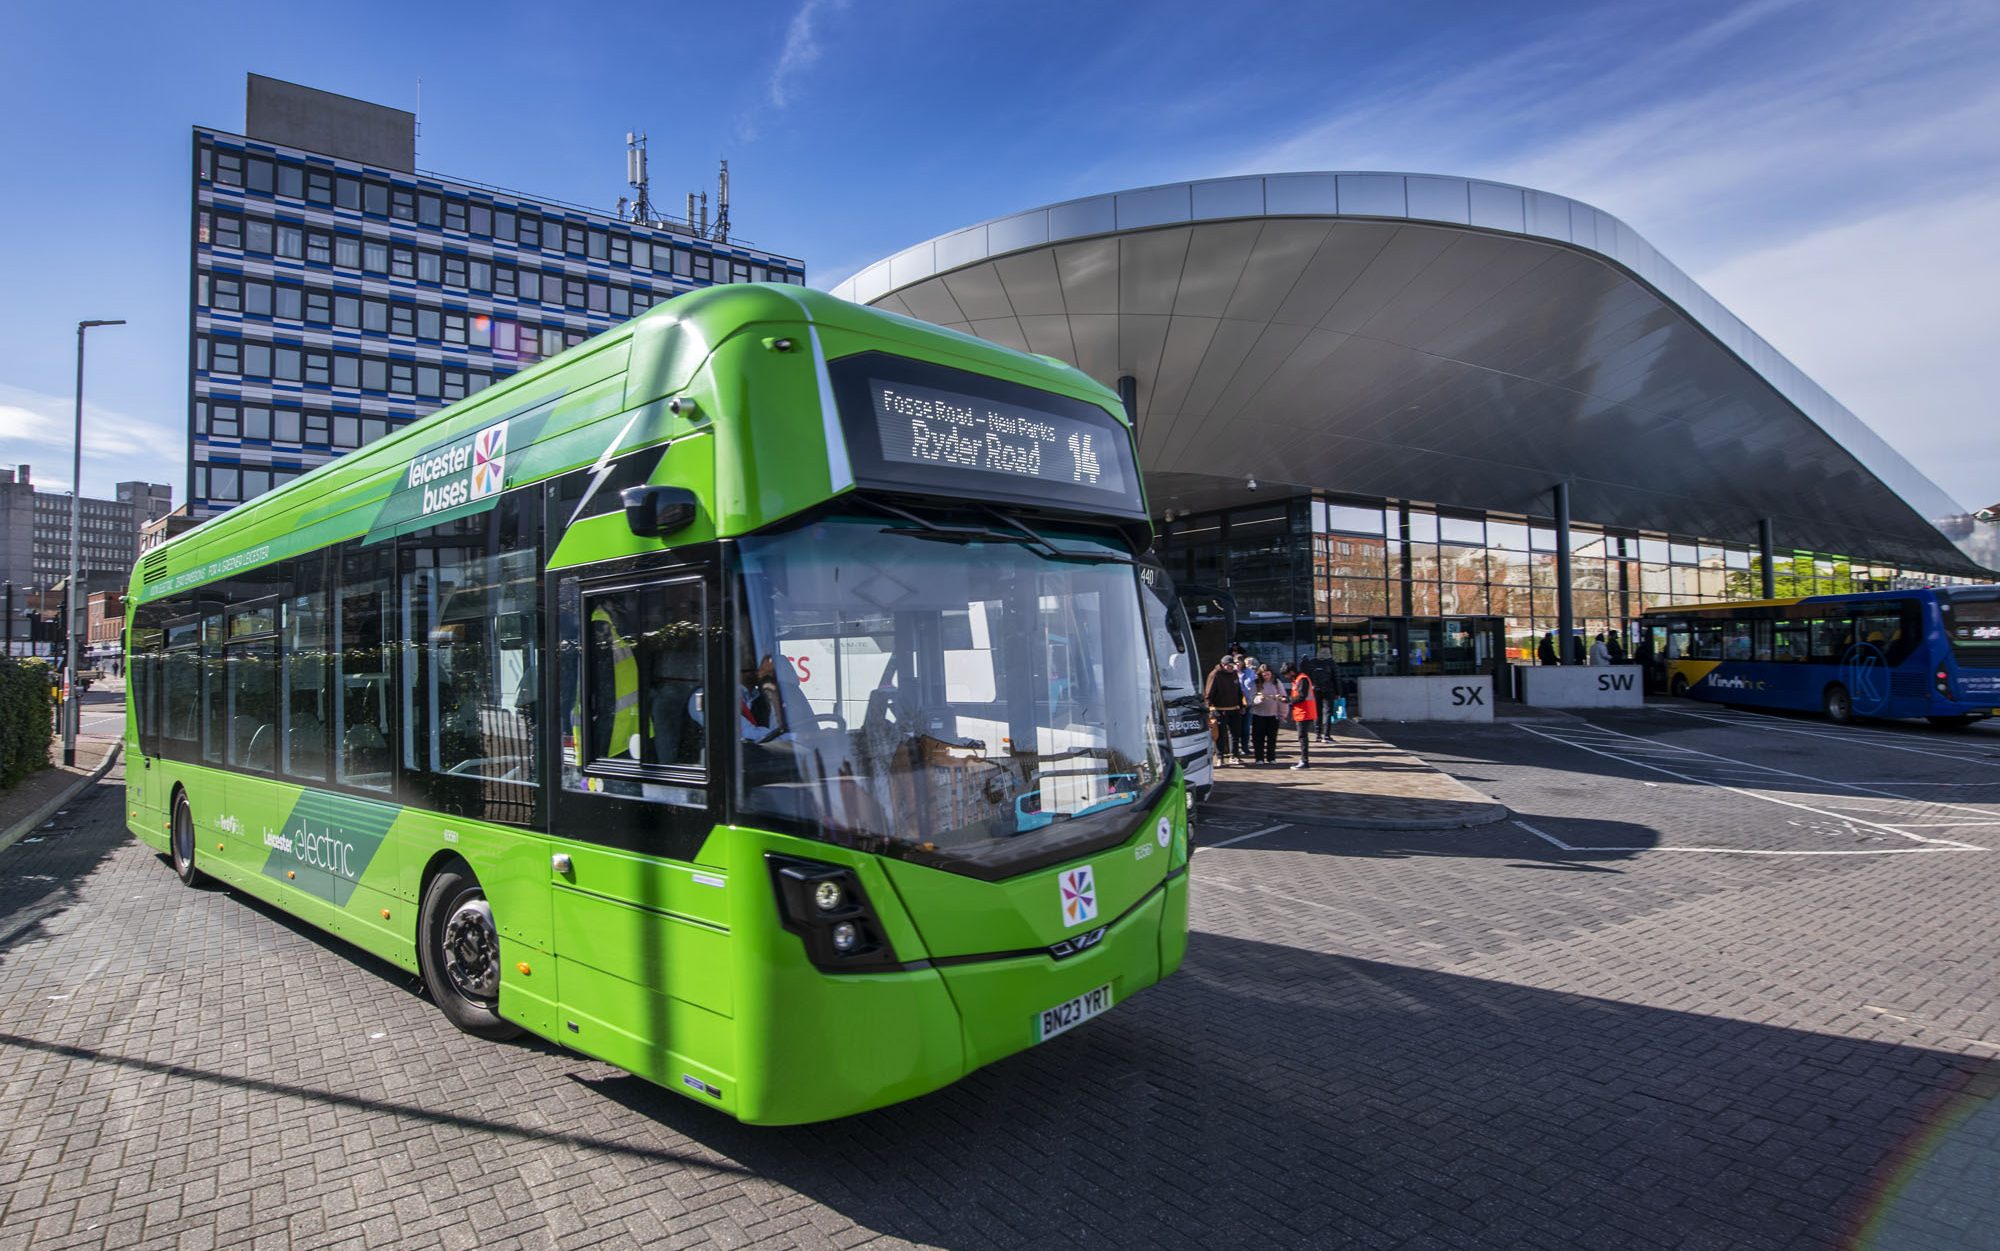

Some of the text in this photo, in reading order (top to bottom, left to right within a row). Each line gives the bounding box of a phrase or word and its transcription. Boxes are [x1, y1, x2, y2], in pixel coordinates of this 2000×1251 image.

[884, 390, 934, 419] Fosse
[935, 401, 974, 427] Road
[987, 411, 1017, 435] New
[1018, 418, 1056, 442] Parks
[407, 443, 473, 489] leicester
[912, 418, 1041, 475] Ryder Road
[1067, 432, 1101, 484] 14
[422, 478, 469, 515] buses
[1140, 567, 1154, 586] 440
[1451, 685, 1485, 706] SX
[1597, 673, 1635, 691] SW
[262, 826, 293, 853] Leicester
[294, 818, 355, 878] electric
[1043, 985, 1110, 1035] BN23 YRT
